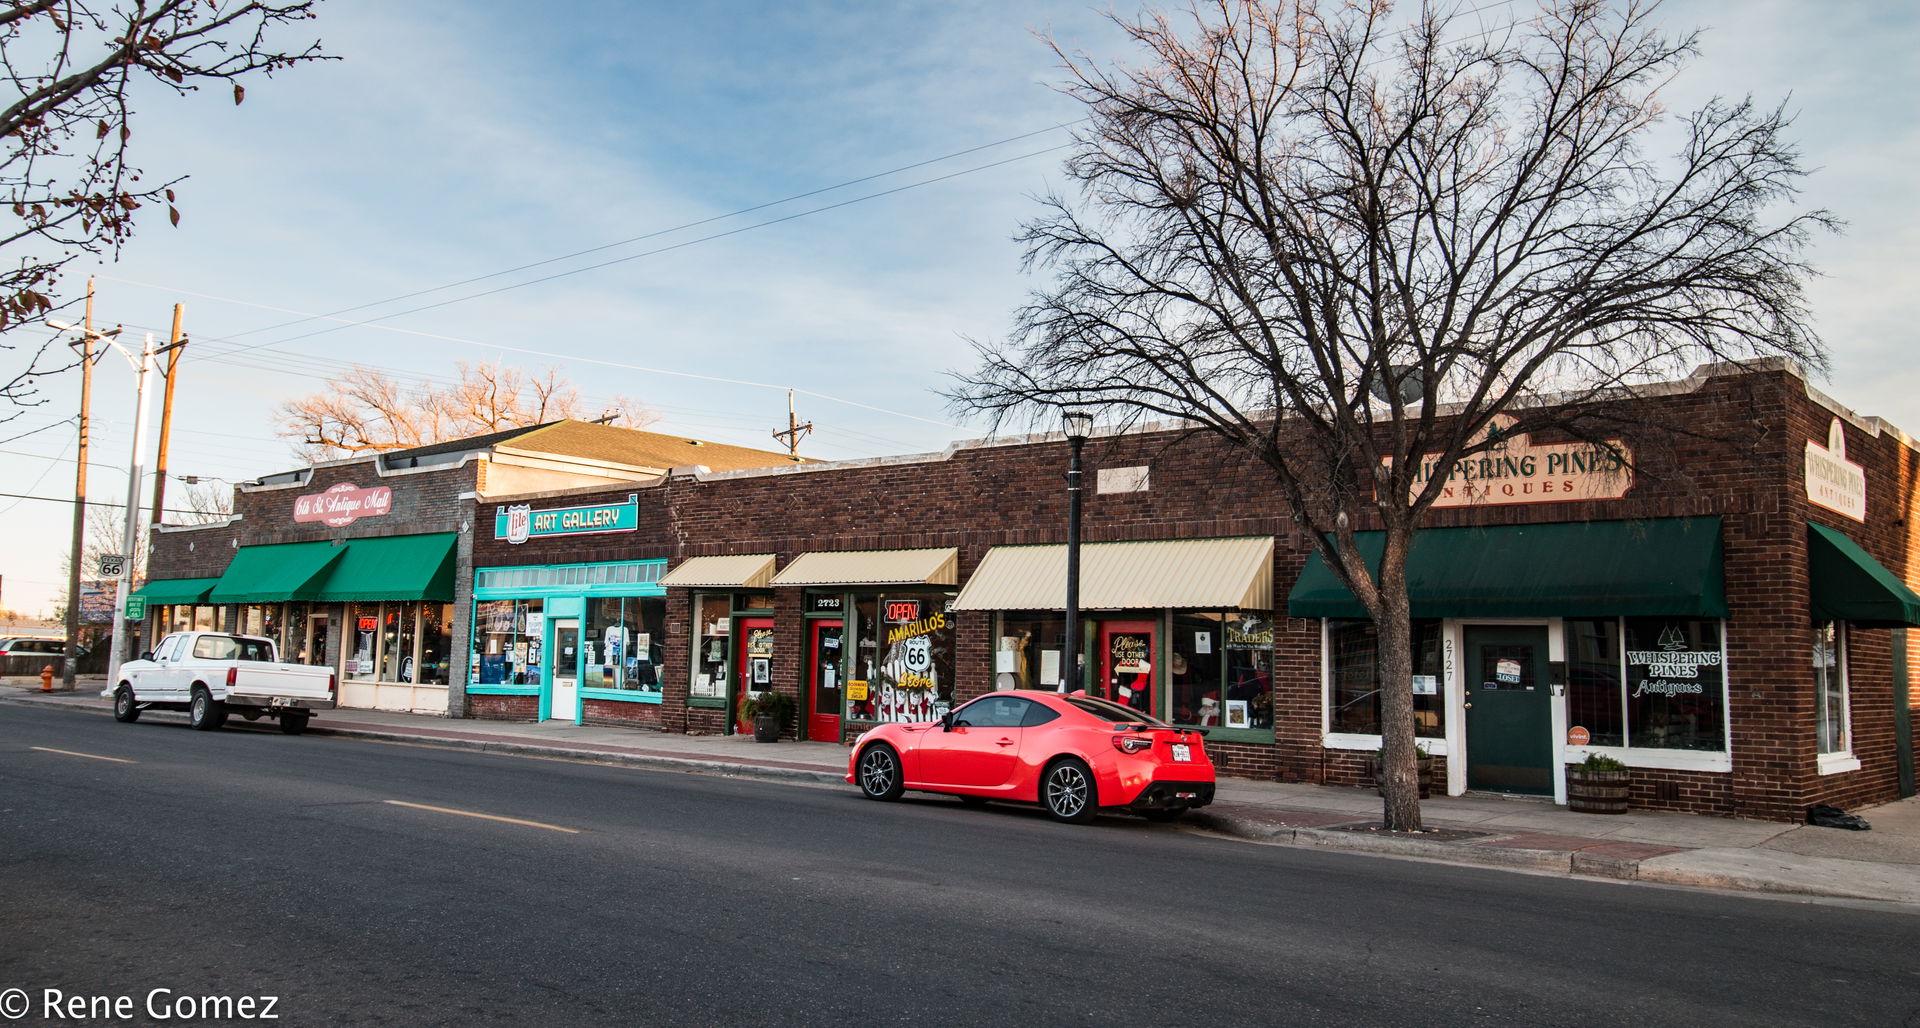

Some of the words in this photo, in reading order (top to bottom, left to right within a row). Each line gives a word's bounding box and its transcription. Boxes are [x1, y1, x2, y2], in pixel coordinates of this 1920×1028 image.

[1384, 454, 1536, 483] IPERING
[1546, 449, 1624, 475] PINES
[1808, 451, 1847, 491] WHISPERING
[1442, 480, 1574, 498] NTIQUES
[296, 498, 310, 516] 6th
[326, 494, 361, 516] Antique
[364, 489, 390, 509] Mall
[511, 512, 527, 537] Lile
[534, 513, 557, 530] ART
[562, 508, 620, 529] GALLERY
[102, 564, 120, 575] 66
[817, 598, 840, 607] 2723
[888, 603, 917, 620] OPEN
[359, 617, 377, 630] OPEN
[887, 612, 945, 645] AMARILLO'S
[1227, 627, 1274, 643] TRADERS
[1111, 635, 1146, 654] Please
[908, 648, 925, 665] 66
[1626, 650, 1721, 666] WHISPERING
[897, 671, 936, 688] Store
[1648, 664, 1699, 678] PINES
[1631, 679, 1703, 698] Antiques
